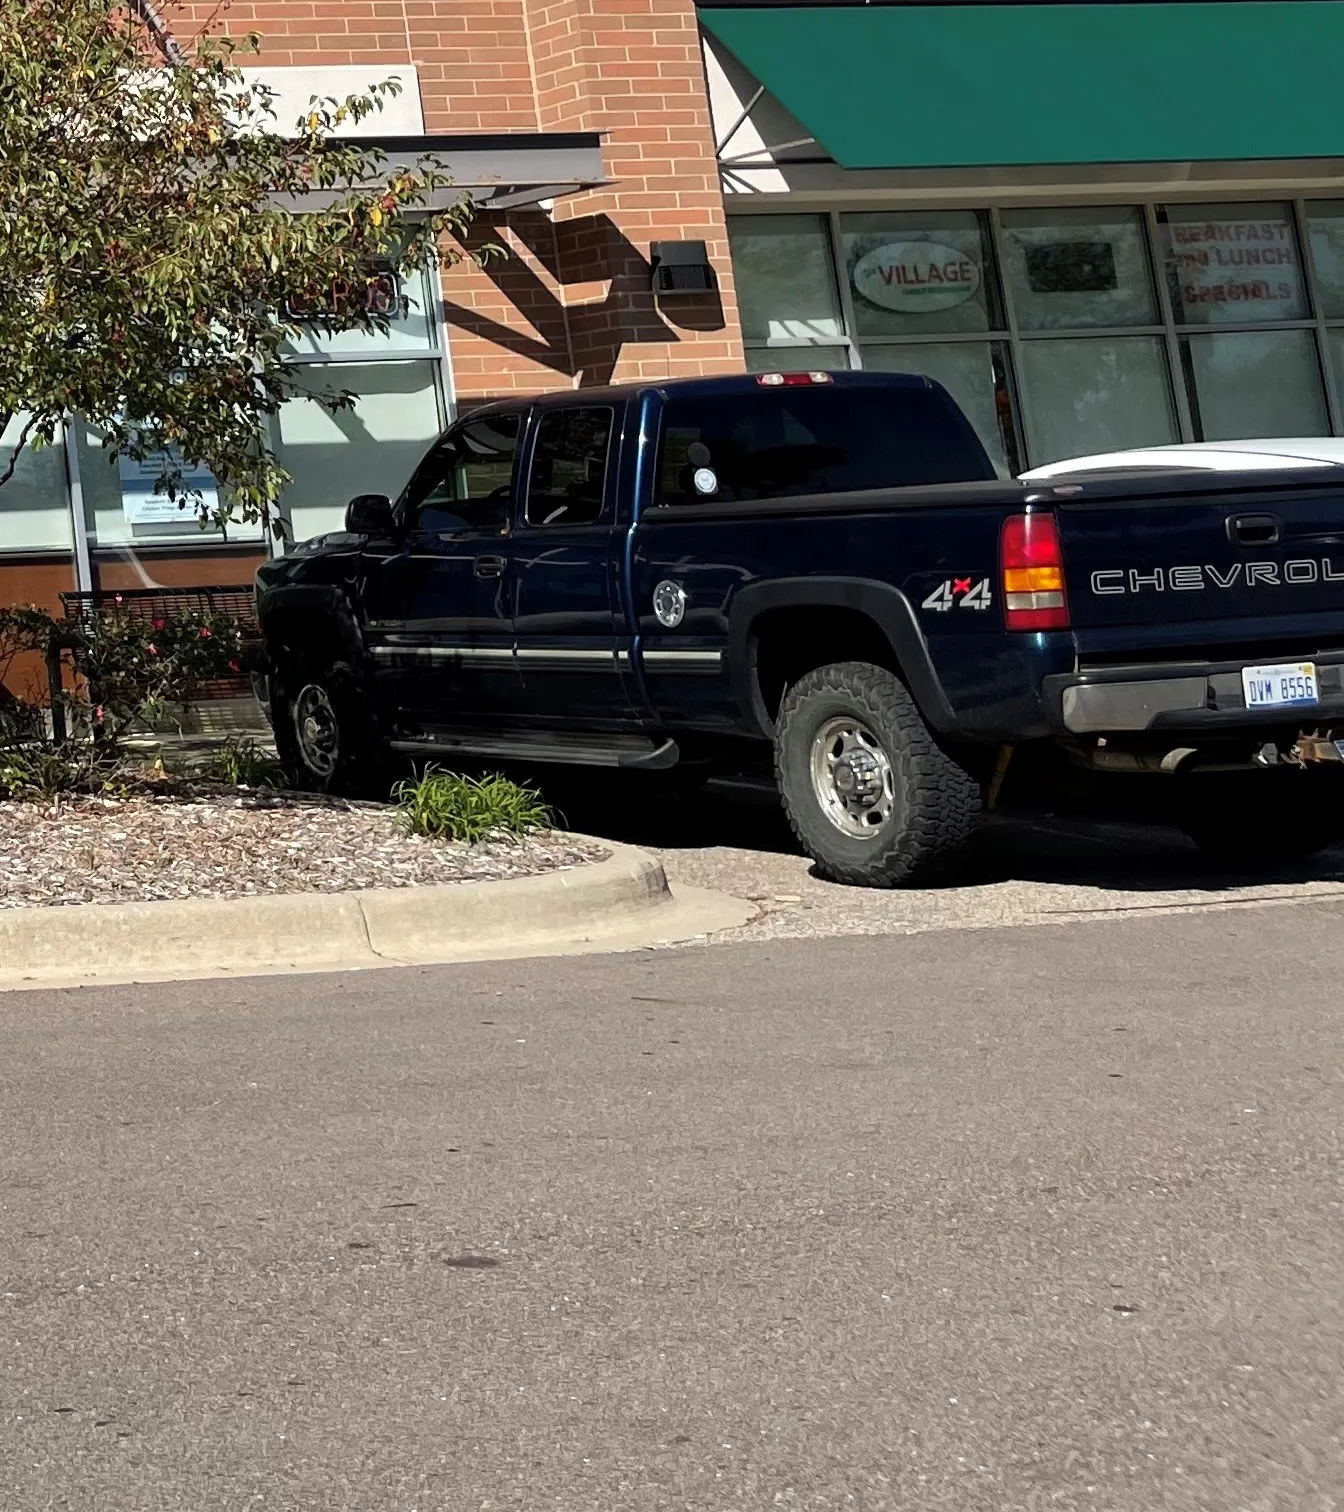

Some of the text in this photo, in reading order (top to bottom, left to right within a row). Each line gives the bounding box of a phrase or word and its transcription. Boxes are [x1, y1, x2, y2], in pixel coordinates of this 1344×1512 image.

[1215, 246, 1292, 266] LUNCH
[876, 261, 973, 286] VILLAGE
[1280, 676, 1313, 699] 8556
